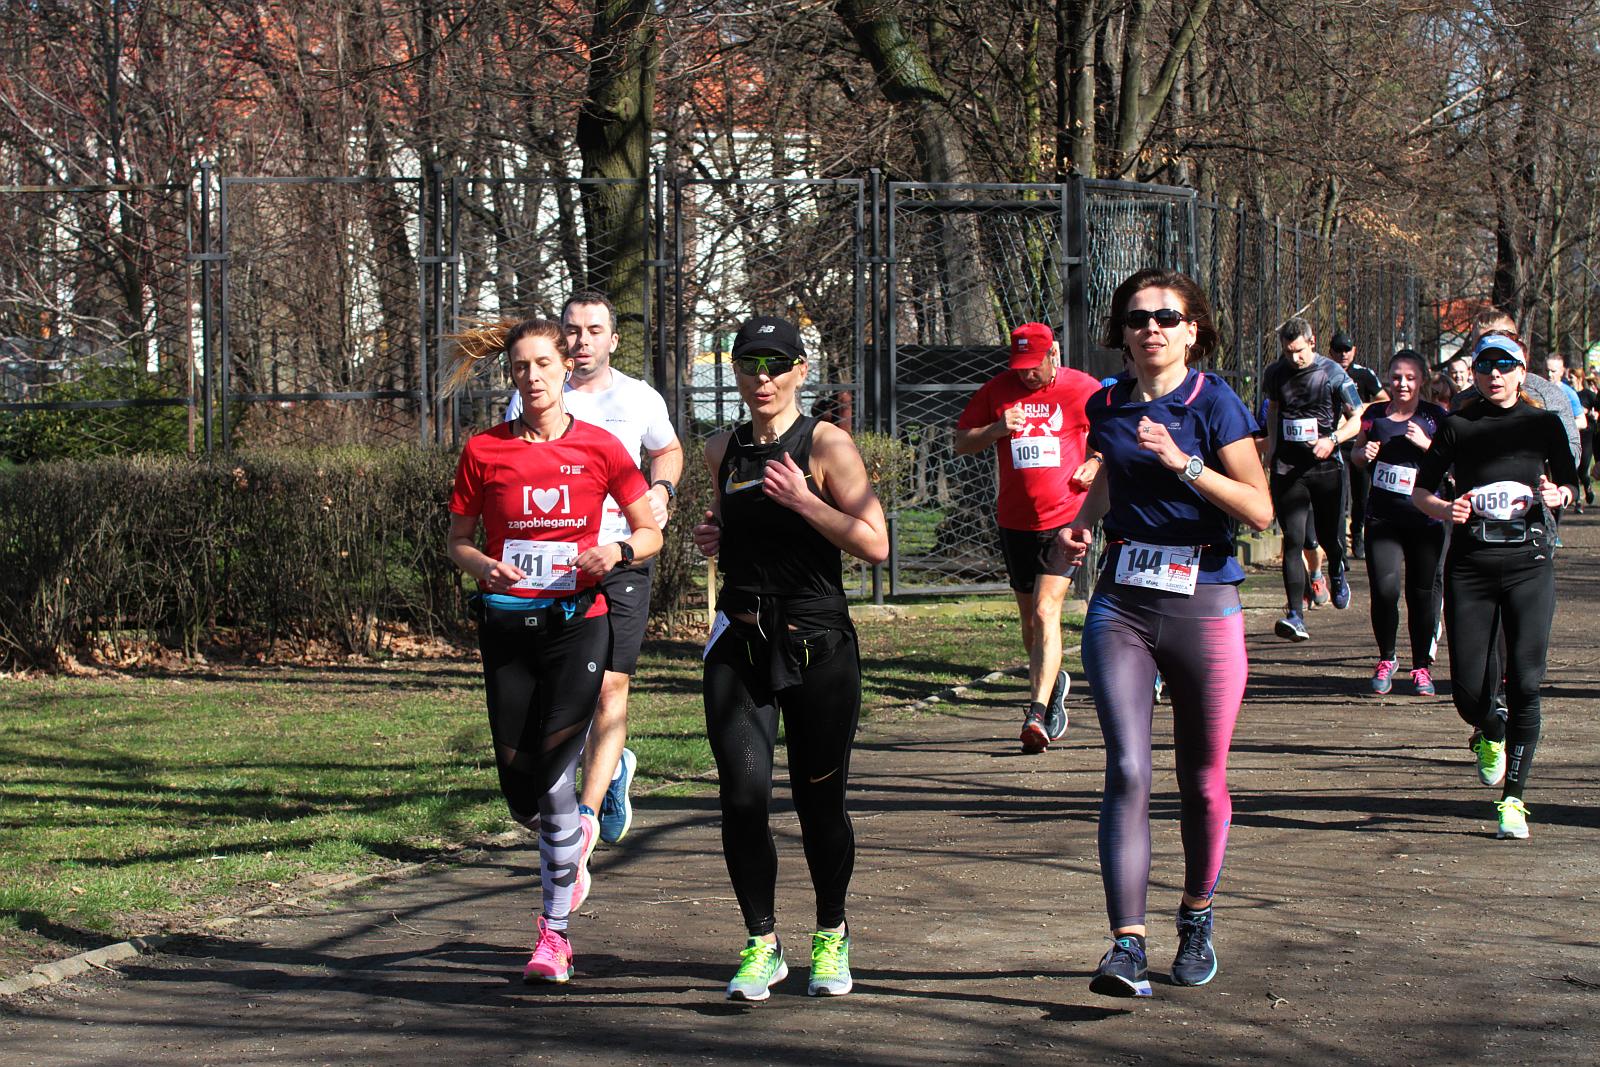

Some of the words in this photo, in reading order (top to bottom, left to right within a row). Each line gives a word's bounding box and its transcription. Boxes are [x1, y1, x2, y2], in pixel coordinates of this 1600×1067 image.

[1024, 404, 1049, 413] RUN
[1286, 426, 1302, 436] 057
[1016, 446, 1039, 460] 109
[1377, 470, 1396, 484] 210
[1476, 492, 1508, 511] 058
[508, 516, 587, 530] zapobiegam.pl
[512, 553, 543, 577] 141
[1128, 548, 1163, 574] 144
